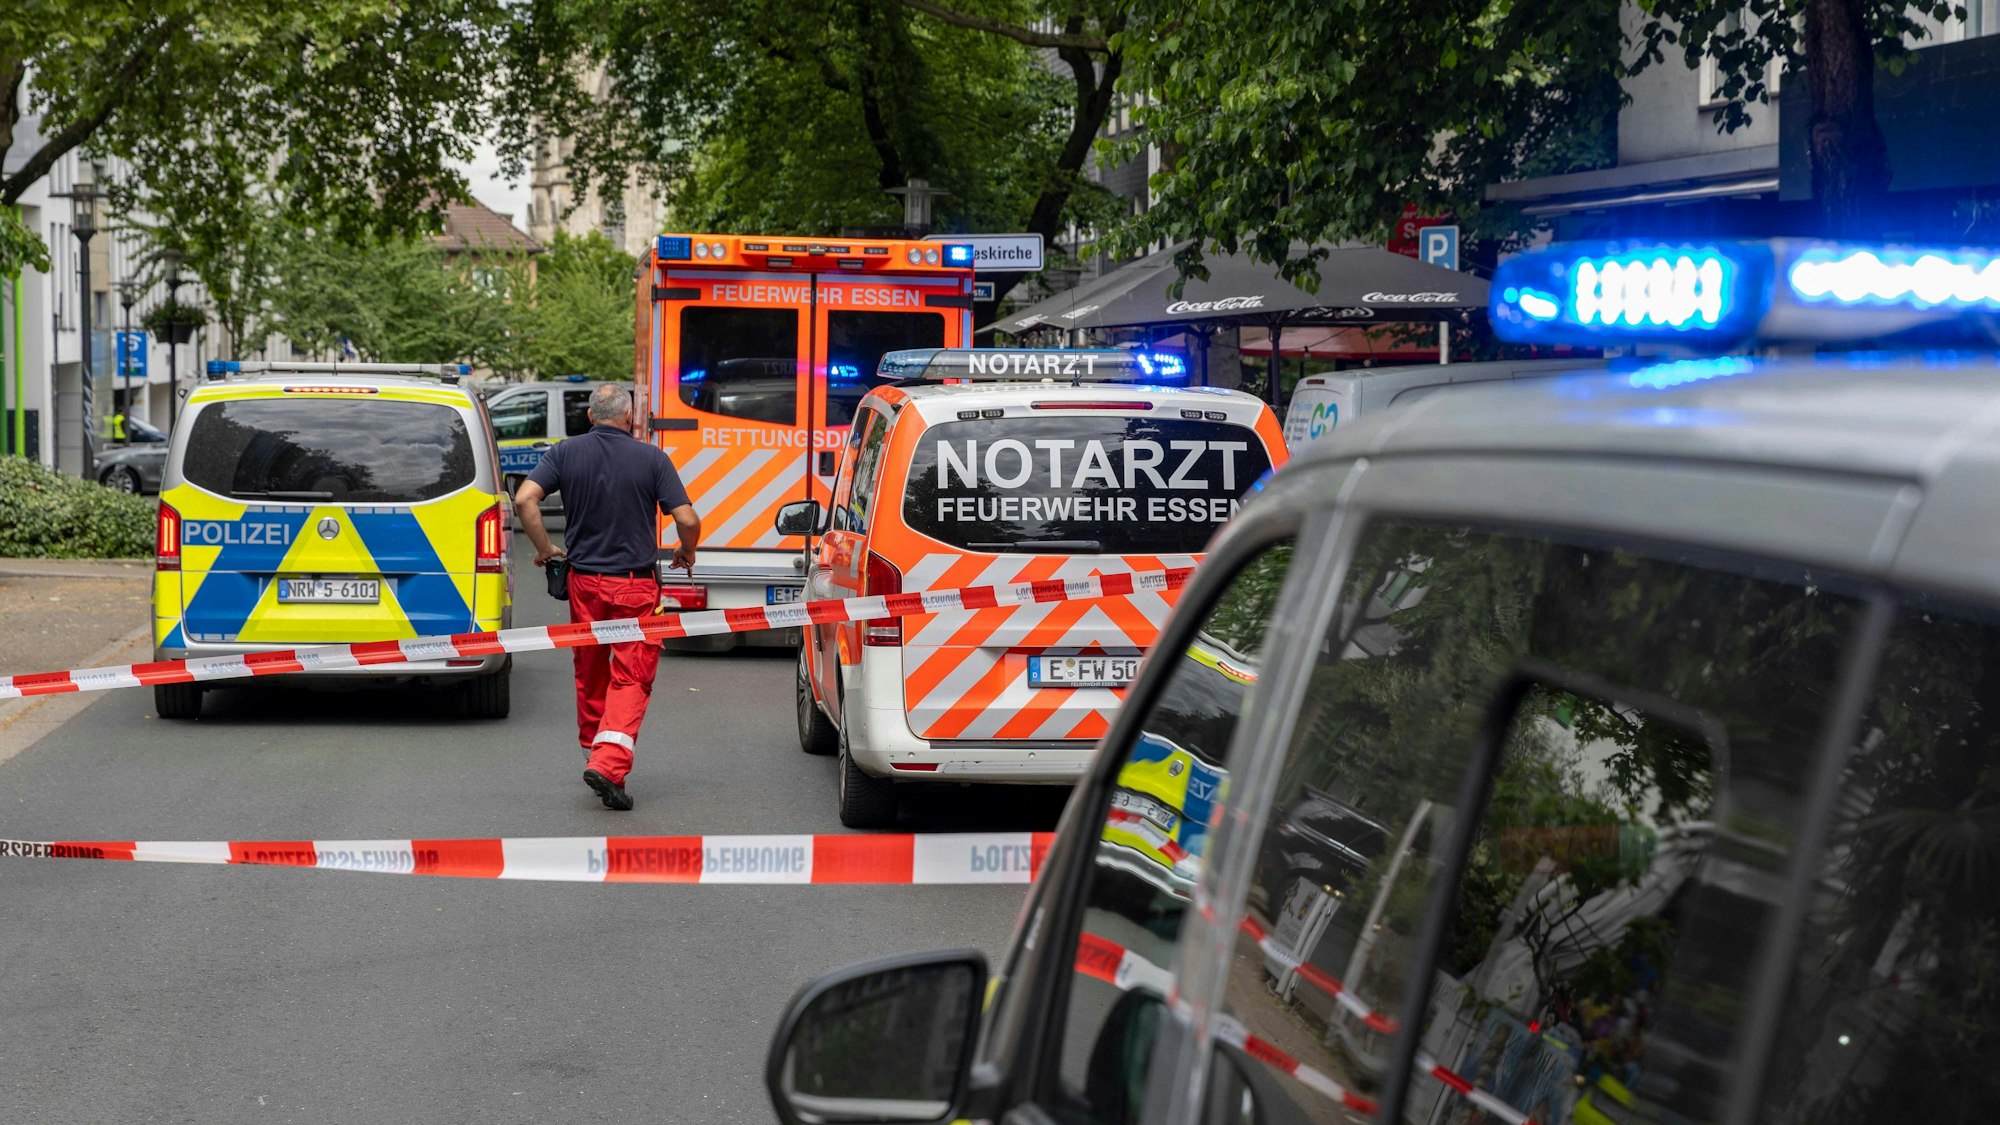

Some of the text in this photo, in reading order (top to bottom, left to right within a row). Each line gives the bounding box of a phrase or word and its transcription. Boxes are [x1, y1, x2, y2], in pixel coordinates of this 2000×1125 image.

[712, 284, 920, 306] FEUERWEHR ESSEN
[969, 353, 1099, 375] NOTARZT
[936, 439, 1248, 491] NOTARZT
[937, 497, 1139, 522] FEUERWEHR
[184, 521, 290, 545] POLIZEI
[288, 582, 315, 598] NRW
[324, 582, 378, 598] 5-6101
[1050, 660, 1063, 680] E
[1079, 660, 1106, 680] FW
